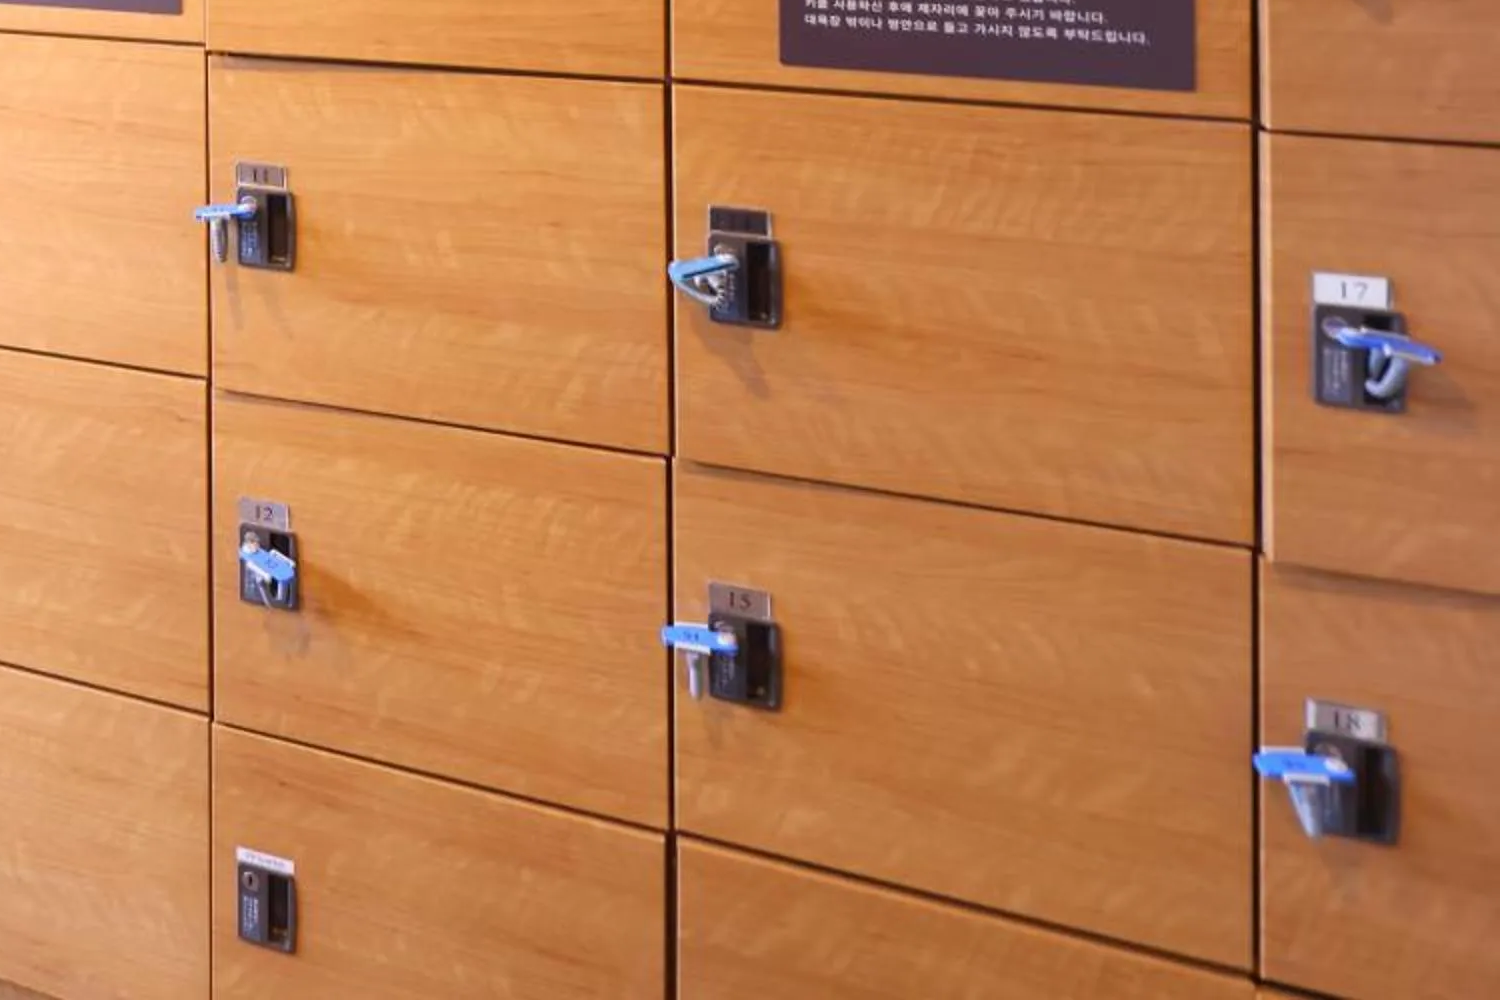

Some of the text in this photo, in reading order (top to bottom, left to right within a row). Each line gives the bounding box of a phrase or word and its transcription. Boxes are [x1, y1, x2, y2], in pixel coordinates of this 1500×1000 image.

[1341, 280, 1368, 301] 17
[255, 504, 273, 521] 12
[729, 591, 751, 609] 15
[1334, 710, 1362, 730] 18
